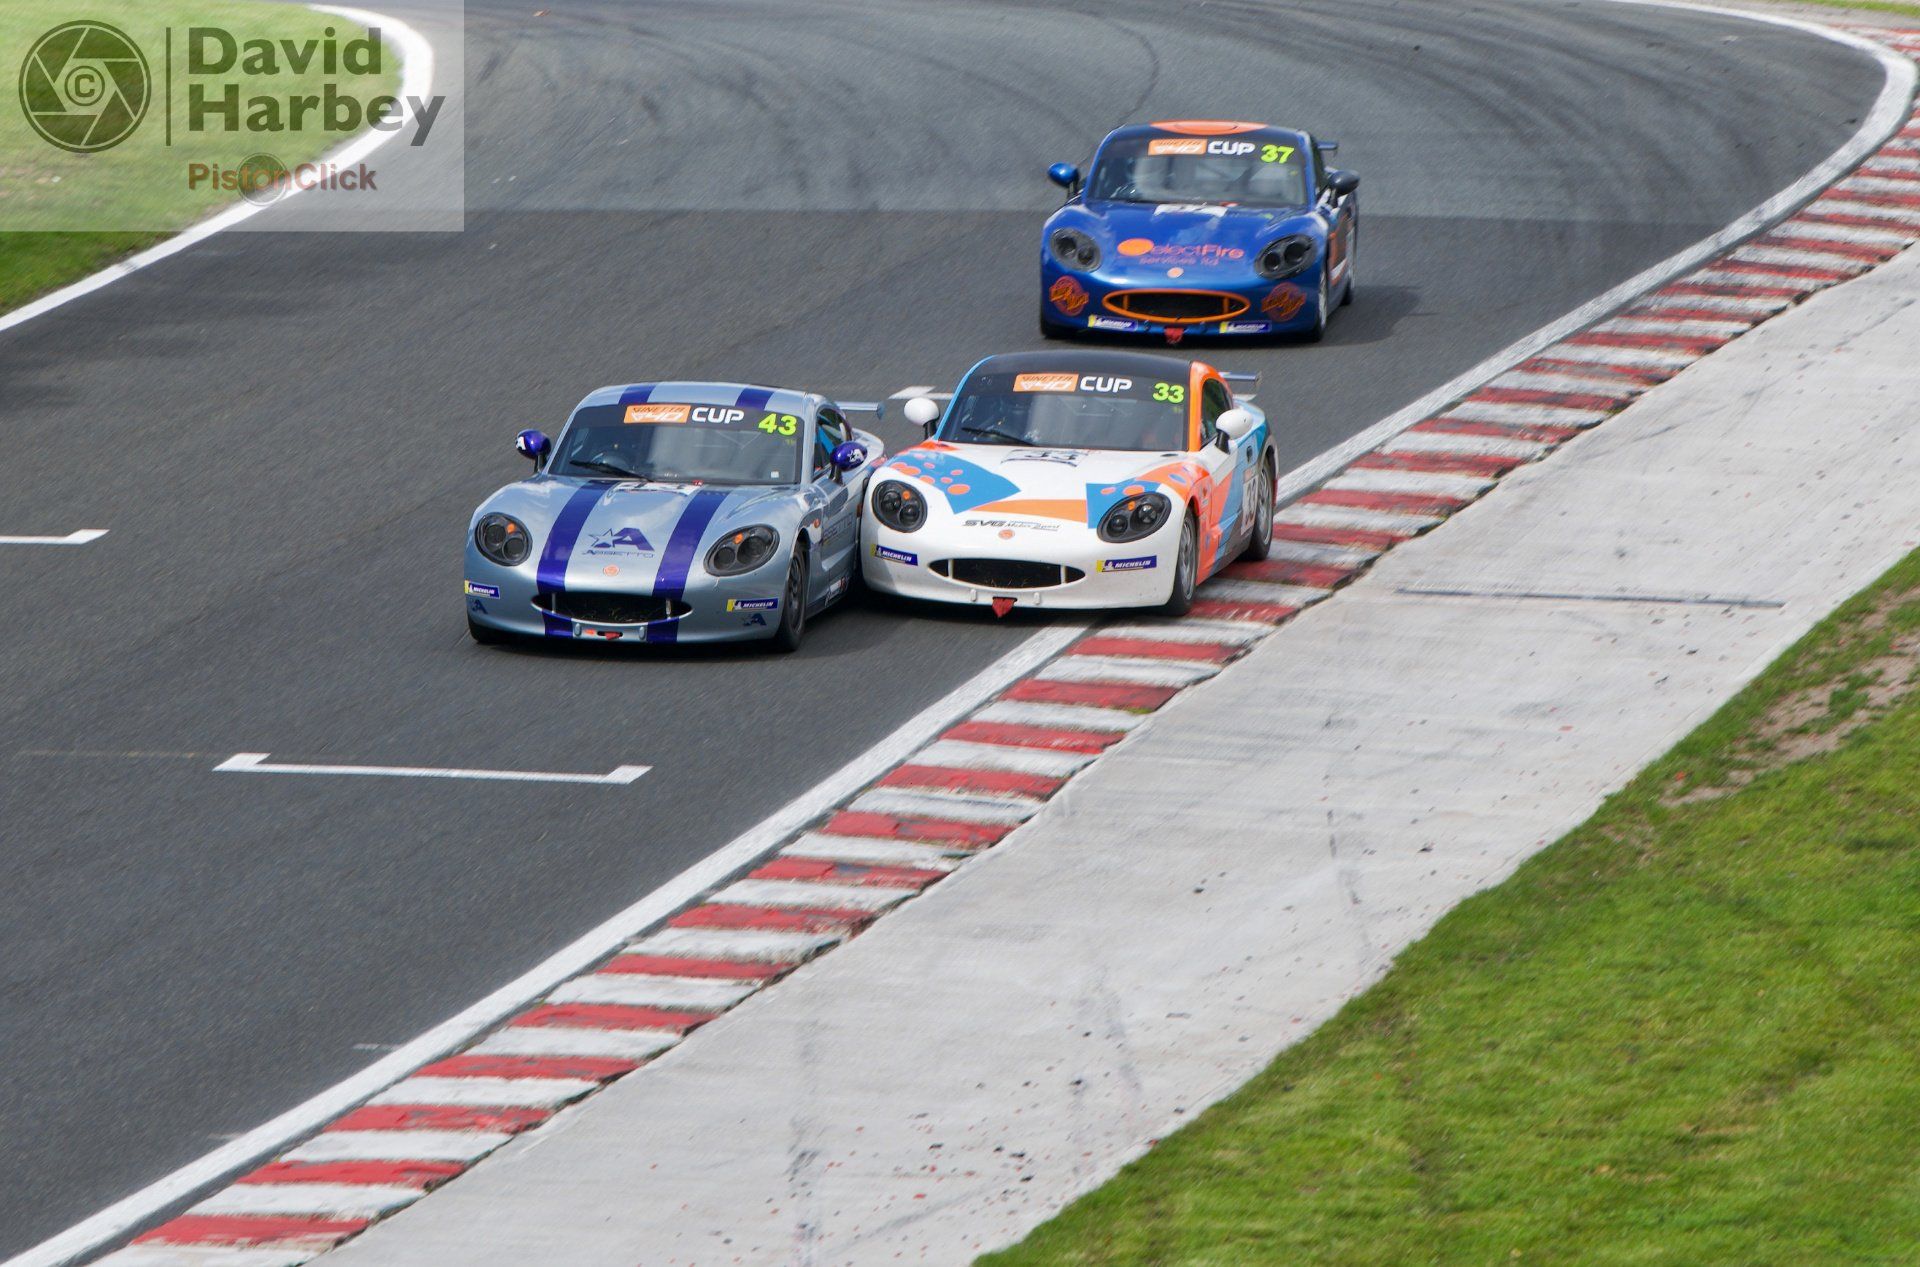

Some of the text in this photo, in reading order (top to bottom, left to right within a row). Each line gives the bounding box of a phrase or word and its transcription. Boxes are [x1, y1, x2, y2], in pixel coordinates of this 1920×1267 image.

[1207, 140, 1256, 155] CUP
[1260, 144, 1295, 164] 37
[1079, 376, 1133, 393] CUP
[1152, 382, 1185, 404] 33
[691, 407, 745, 424] CUP
[758, 413, 797, 436] 43
[882, 550, 912, 562] MICHELIN
[1114, 560, 1151, 569] MICHELIN
[742, 601, 774, 609] MICHELIN
